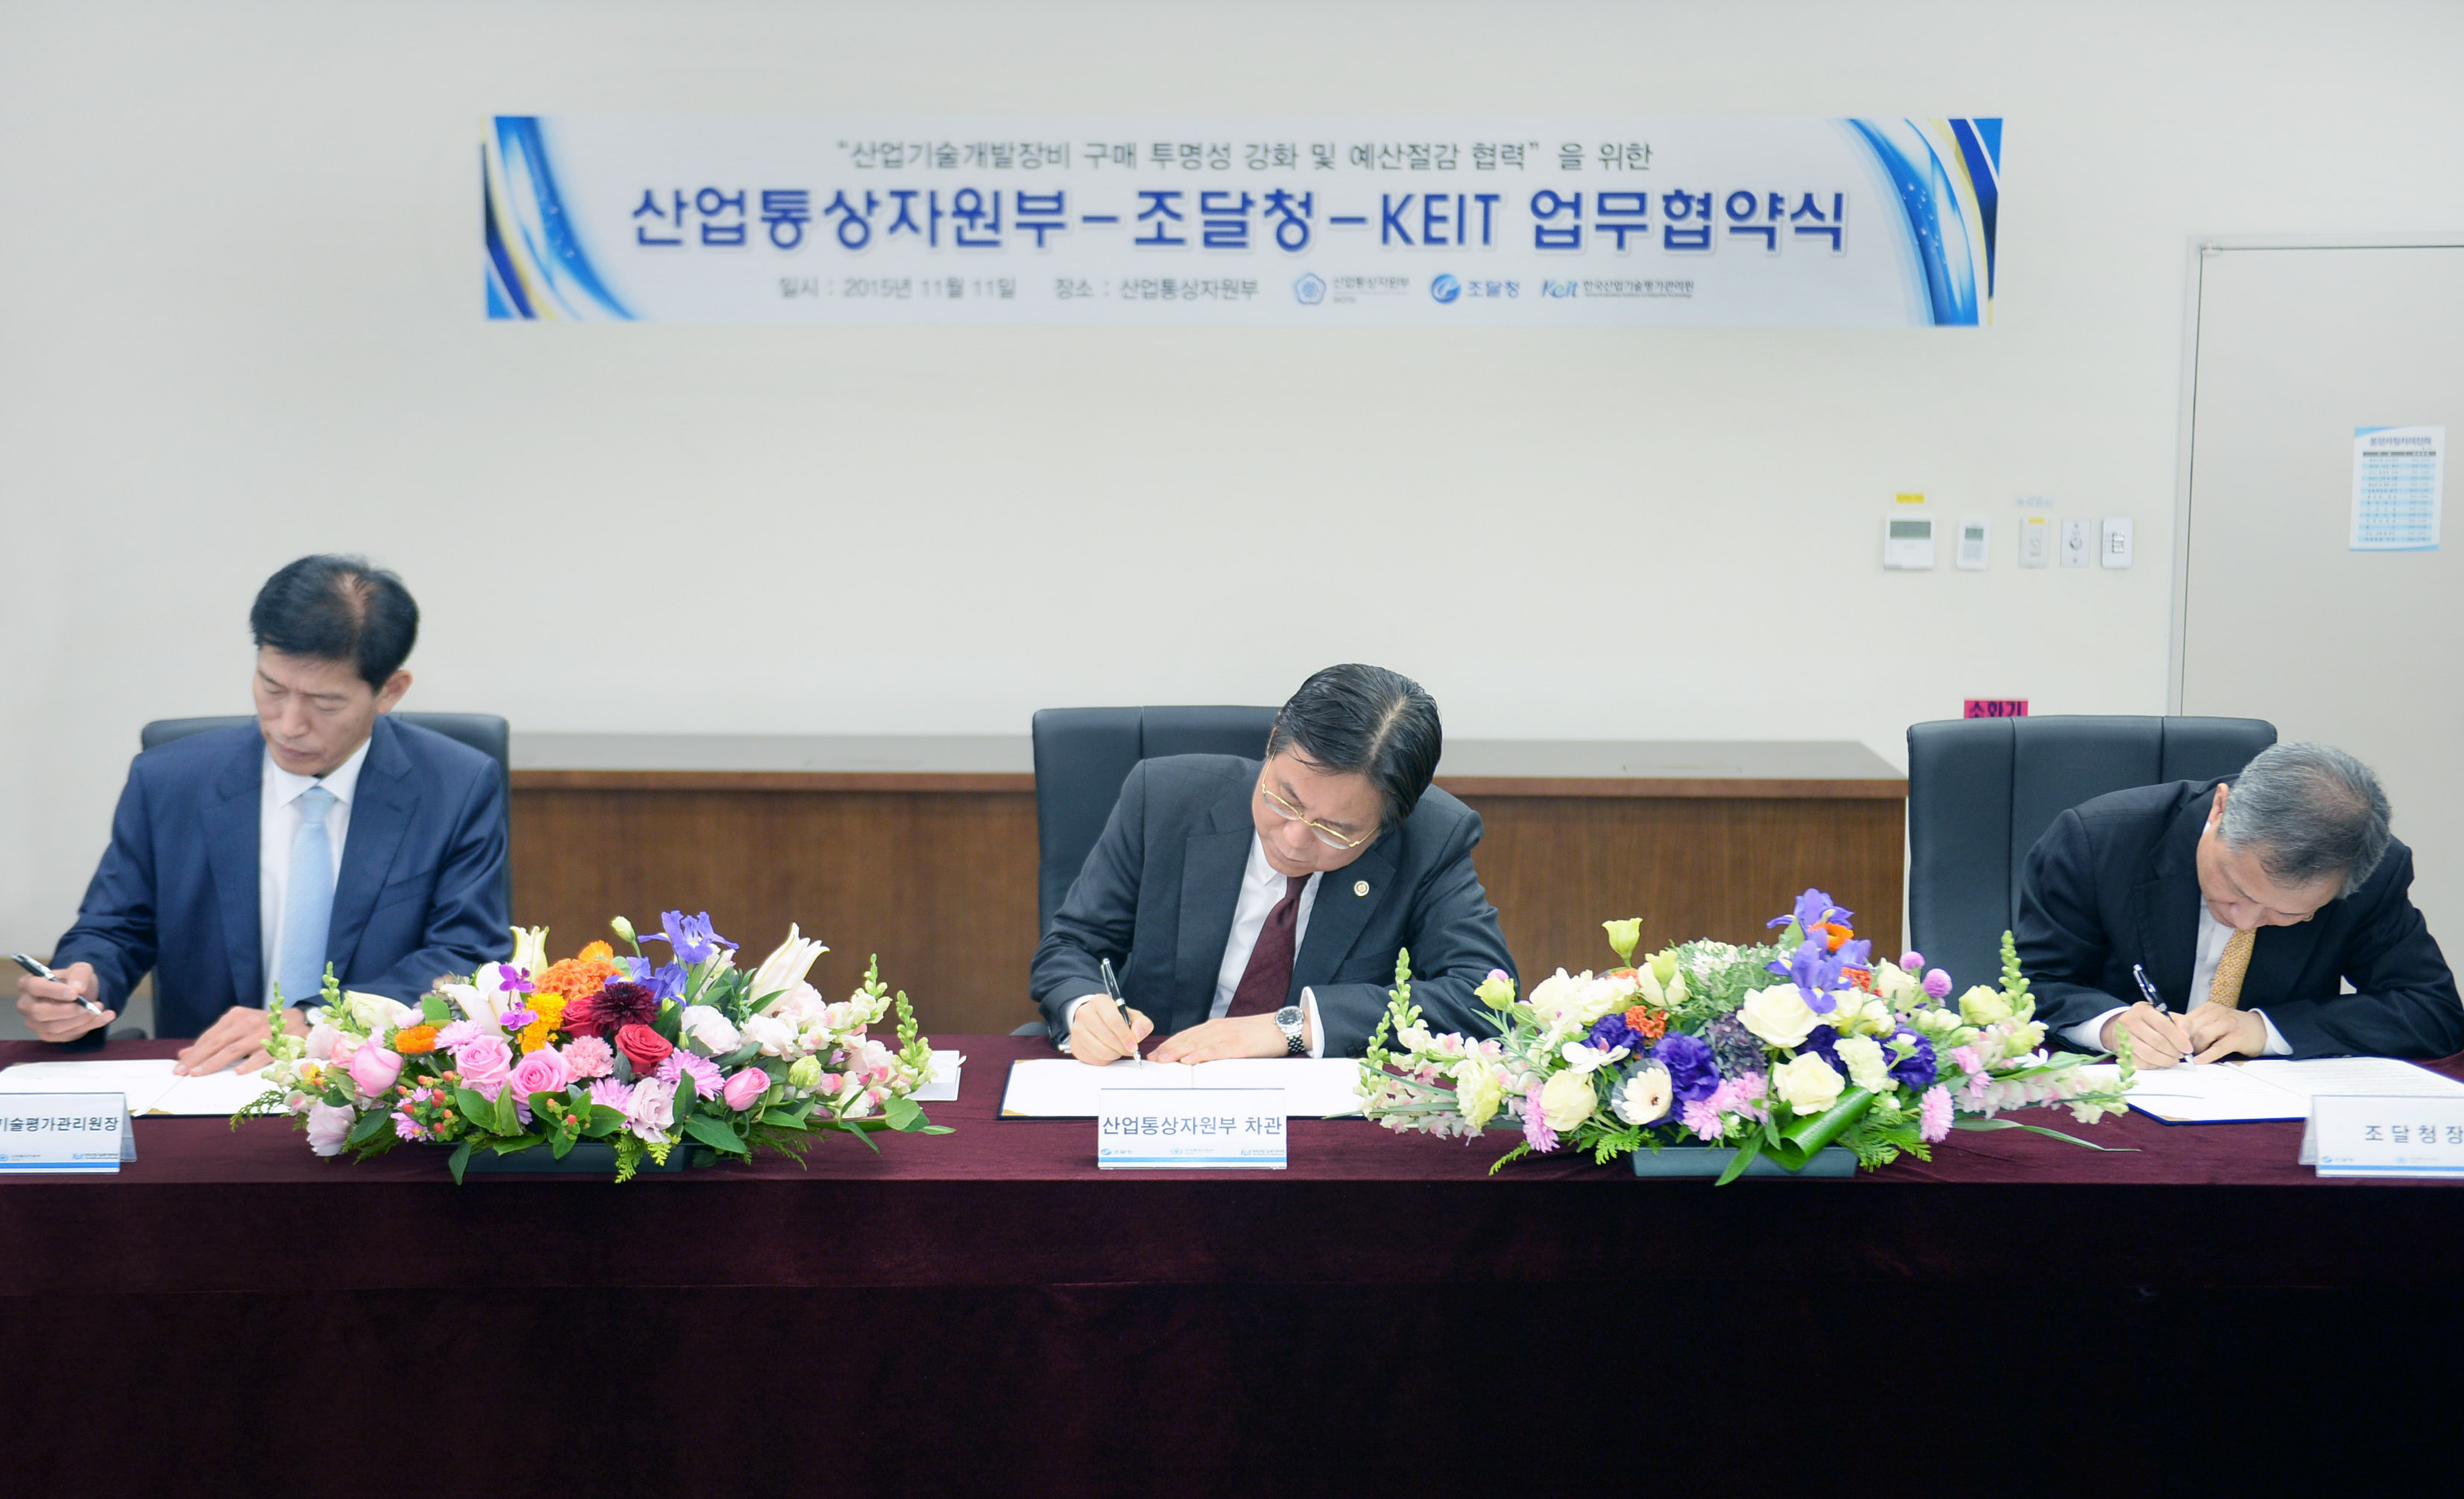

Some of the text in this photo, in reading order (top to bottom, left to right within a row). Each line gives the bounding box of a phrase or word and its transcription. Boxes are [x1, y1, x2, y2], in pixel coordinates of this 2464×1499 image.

[1084, 142, 1137, 171] 구매
[1151, 142, 1232, 171] 투명성
[1245, 142, 1300, 171] 강화
[1312, 142, 1337, 171] 및
[1350, 142, 1461, 171] 예산절감
[1558, 142, 1585, 171] 을
[1598, 142, 1653, 171] 위한
[1530, 189, 1844, 252] 업무협약식
[844, 277, 913, 300] 2015년
[922, 277, 964, 300] 11월
[974, 277, 1016, 300] 11일
[1055, 277, 1094, 300] 장소
[1121, 277, 1260, 300] 산업통상자원부
[1467, 279, 1520, 299] 조달청
[1102, 1117, 1283, 1135] 산업통상자원부 차관
